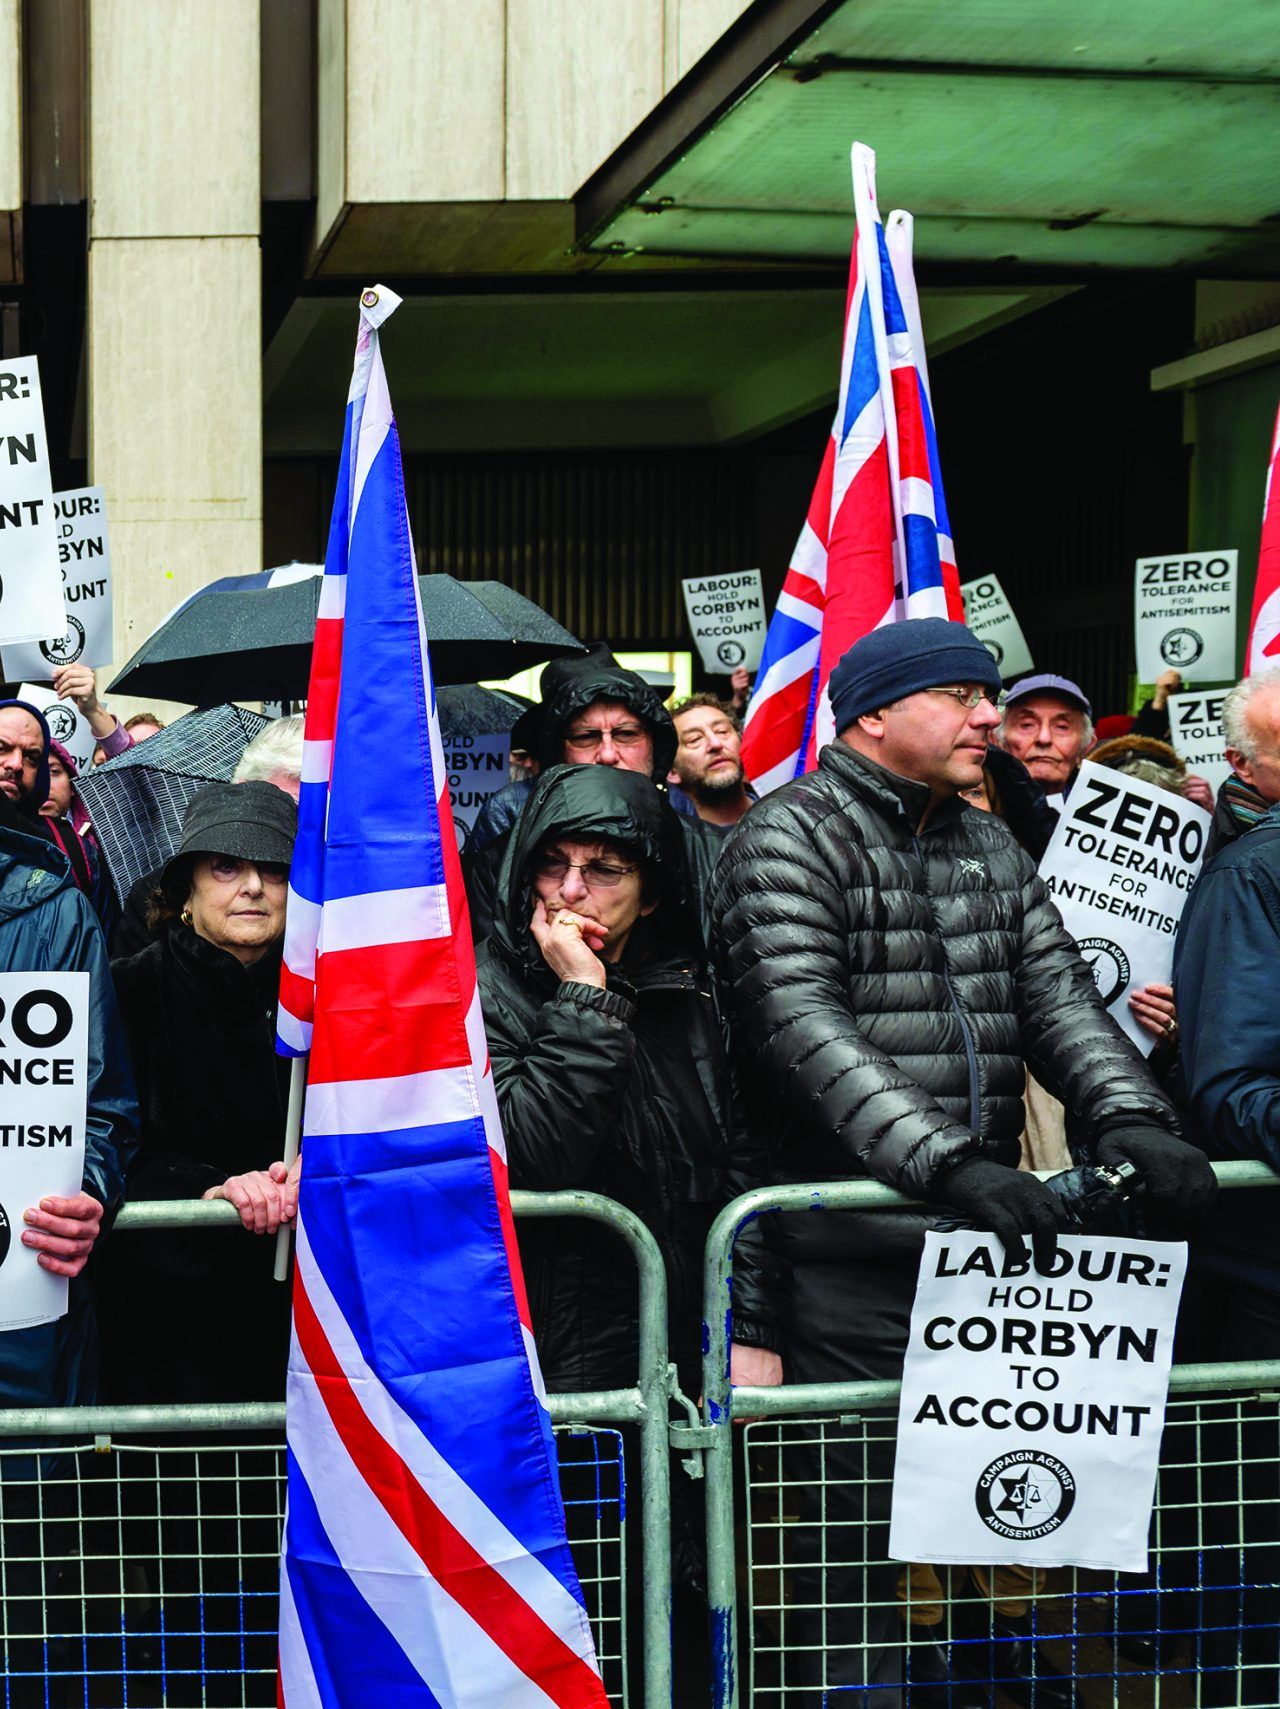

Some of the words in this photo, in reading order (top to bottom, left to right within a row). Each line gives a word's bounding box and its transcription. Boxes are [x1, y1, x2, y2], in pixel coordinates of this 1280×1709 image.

[59, 537, 104, 563] BYN
[1143, 558, 1229, 584] ZERO
[688, 576, 757, 594] LABOUR:
[708, 591, 738, 600] HOLD
[1141, 582, 1231, 597] TOLERANCE
[692, 598, 759, 616] CORBYN
[719, 615, 733, 623] TO
[1141, 606, 1230, 619] ANTISEMITISM
[697, 621, 762, 637] ACCOUNT
[442, 736, 474, 748] OLD
[1073, 779, 1203, 864] ZERO
[1064, 826, 1196, 893] TOLERANCE
[1109, 874, 1147, 897] FOR
[1108, 944, 1129, 983] AGAINST
[935, 1247, 1171, 1287] LABOUR:
[988, 1286, 1093, 1313] HOLD
[924, 1316, 1158, 1363] CORBYN
[1010, 1365, 1059, 1391] TO
[913, 1394, 1151, 1436] ACCOUNT
[980, 1452, 1034, 1488] CAMPAIGN
[1036, 1453, 1074, 1491] AGAINST
[985, 1515, 1061, 1539] ANTISEMITISM
